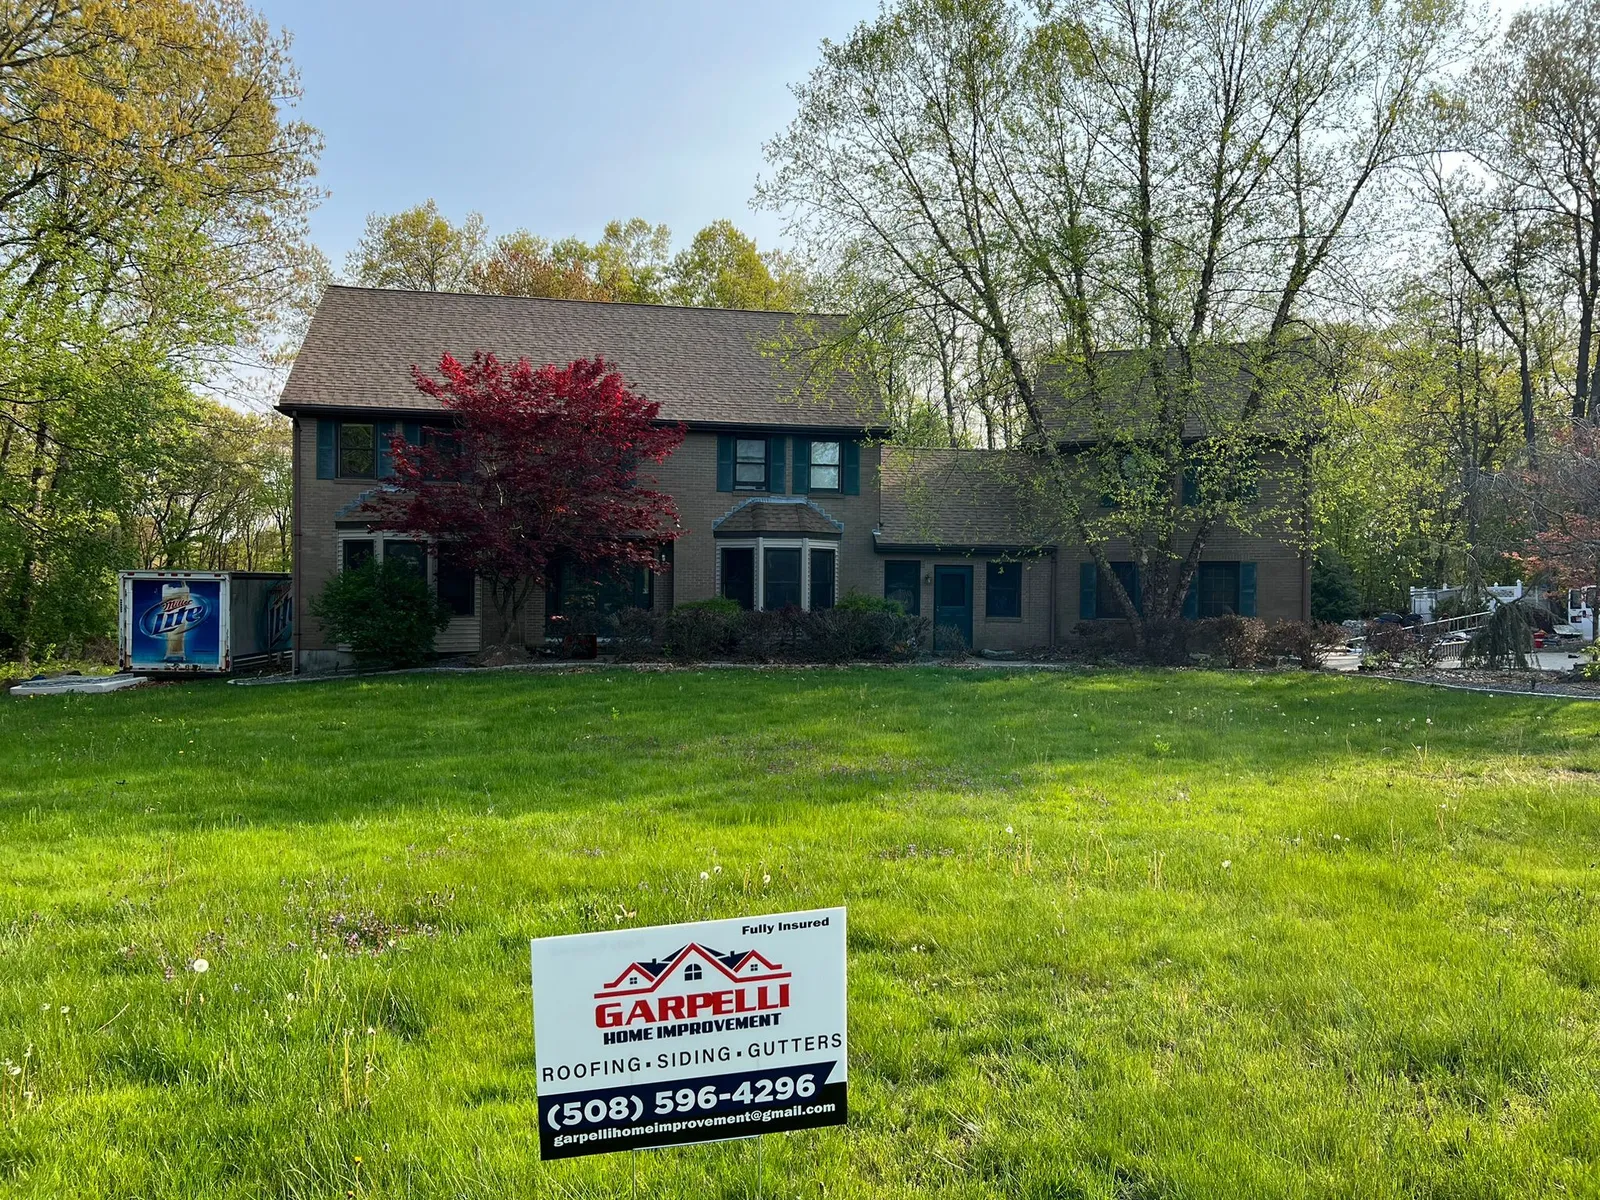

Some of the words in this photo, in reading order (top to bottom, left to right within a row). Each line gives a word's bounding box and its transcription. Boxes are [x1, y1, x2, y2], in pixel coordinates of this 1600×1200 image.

[151, 606, 204, 636] Lite
[163, 599, 193, 611] Miller
[741, 922, 775, 935] Fully
[778, 917, 830, 931] Insured
[594, 983, 790, 1029] GARPELLI
[603, 1027, 654, 1045] HOME
[656, 1012, 782, 1039] IMPROVEMENT
[542, 1057, 641, 1083] ROOFING
[657, 1046, 730, 1069] SIDING
[747, 1033, 842, 1058] GUTTERS
[547, 1094, 644, 1131] (508)
[654, 1073, 816, 1115] 596-4296
[553, 1103, 836, 1147] garpellihomeimprovement@gmail.com
